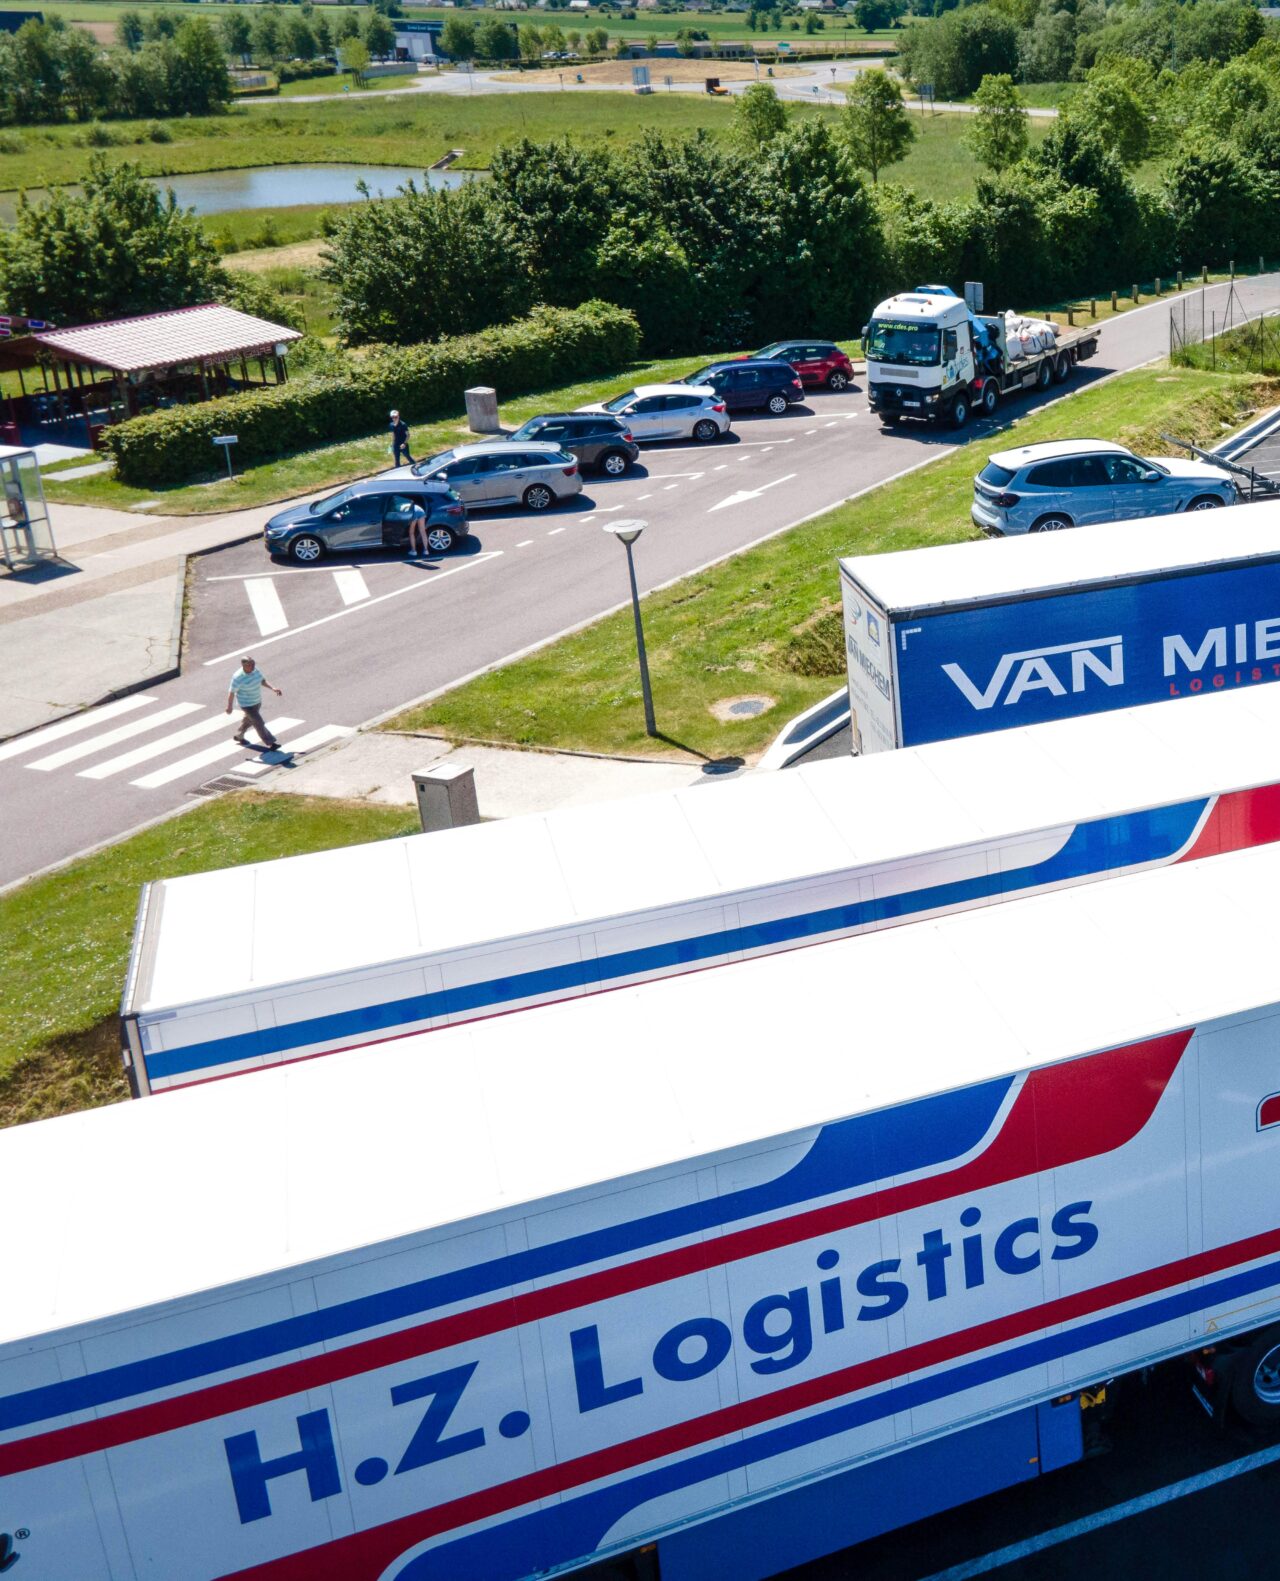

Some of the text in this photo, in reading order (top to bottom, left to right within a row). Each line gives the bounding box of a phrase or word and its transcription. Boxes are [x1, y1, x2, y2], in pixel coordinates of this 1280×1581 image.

[878, 323, 919, 331] www.cdes.pro
[941, 635, 1125, 711] VAN
[223, 1198, 1100, 1525] H.Z. Logistics
